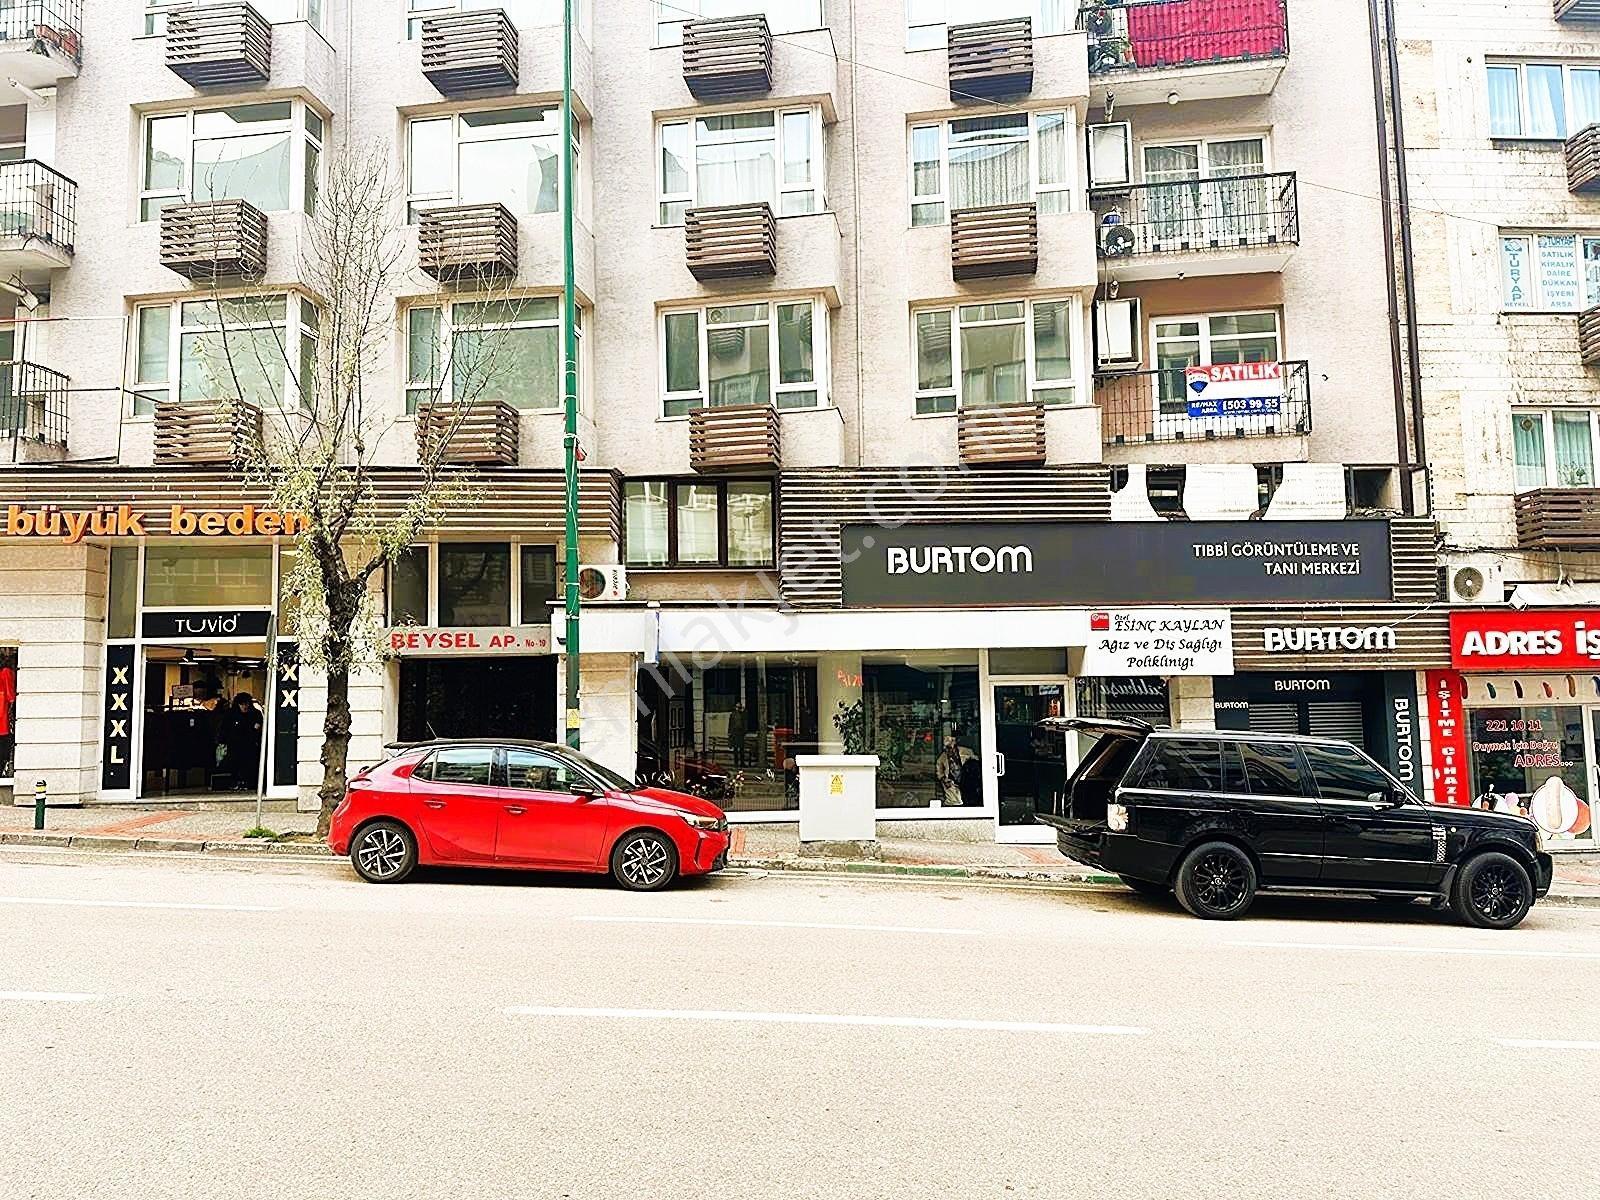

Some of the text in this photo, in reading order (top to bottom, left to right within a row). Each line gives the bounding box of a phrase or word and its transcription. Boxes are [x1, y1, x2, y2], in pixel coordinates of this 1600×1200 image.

[1508, 252, 1523, 302] TURYAP
[1210, 363, 1276, 382] SATILIK
[1264, 398, 1278, 408] 55
[6, 504, 310, 544] büyük beden
[1192, 541, 1360, 557] TIBBİ GÖRÜNTÜLEME VE
[886, 545, 1033, 575] BURTOM
[1263, 559, 1360, 575] TANI MERKEZİ
[1114, 618, 1226, 633] ESİNÇ KAYLAN
[390, 632, 481, 649] BEYSEL
[488, 634, 521, 649] AP.
[1098, 638, 1130, 654] Ağız
[1133, 640, 1149, 650] ve
[1264, 626, 1397, 651] BURTOM
[1460, 629, 1563, 656] ADRES
[1274, 679, 1331, 691] BURTOM
[1214, 700, 1249, 709] BURTOM
[1510, 719, 1526, 732] 10
[1527, 719, 1543, 732] 11
